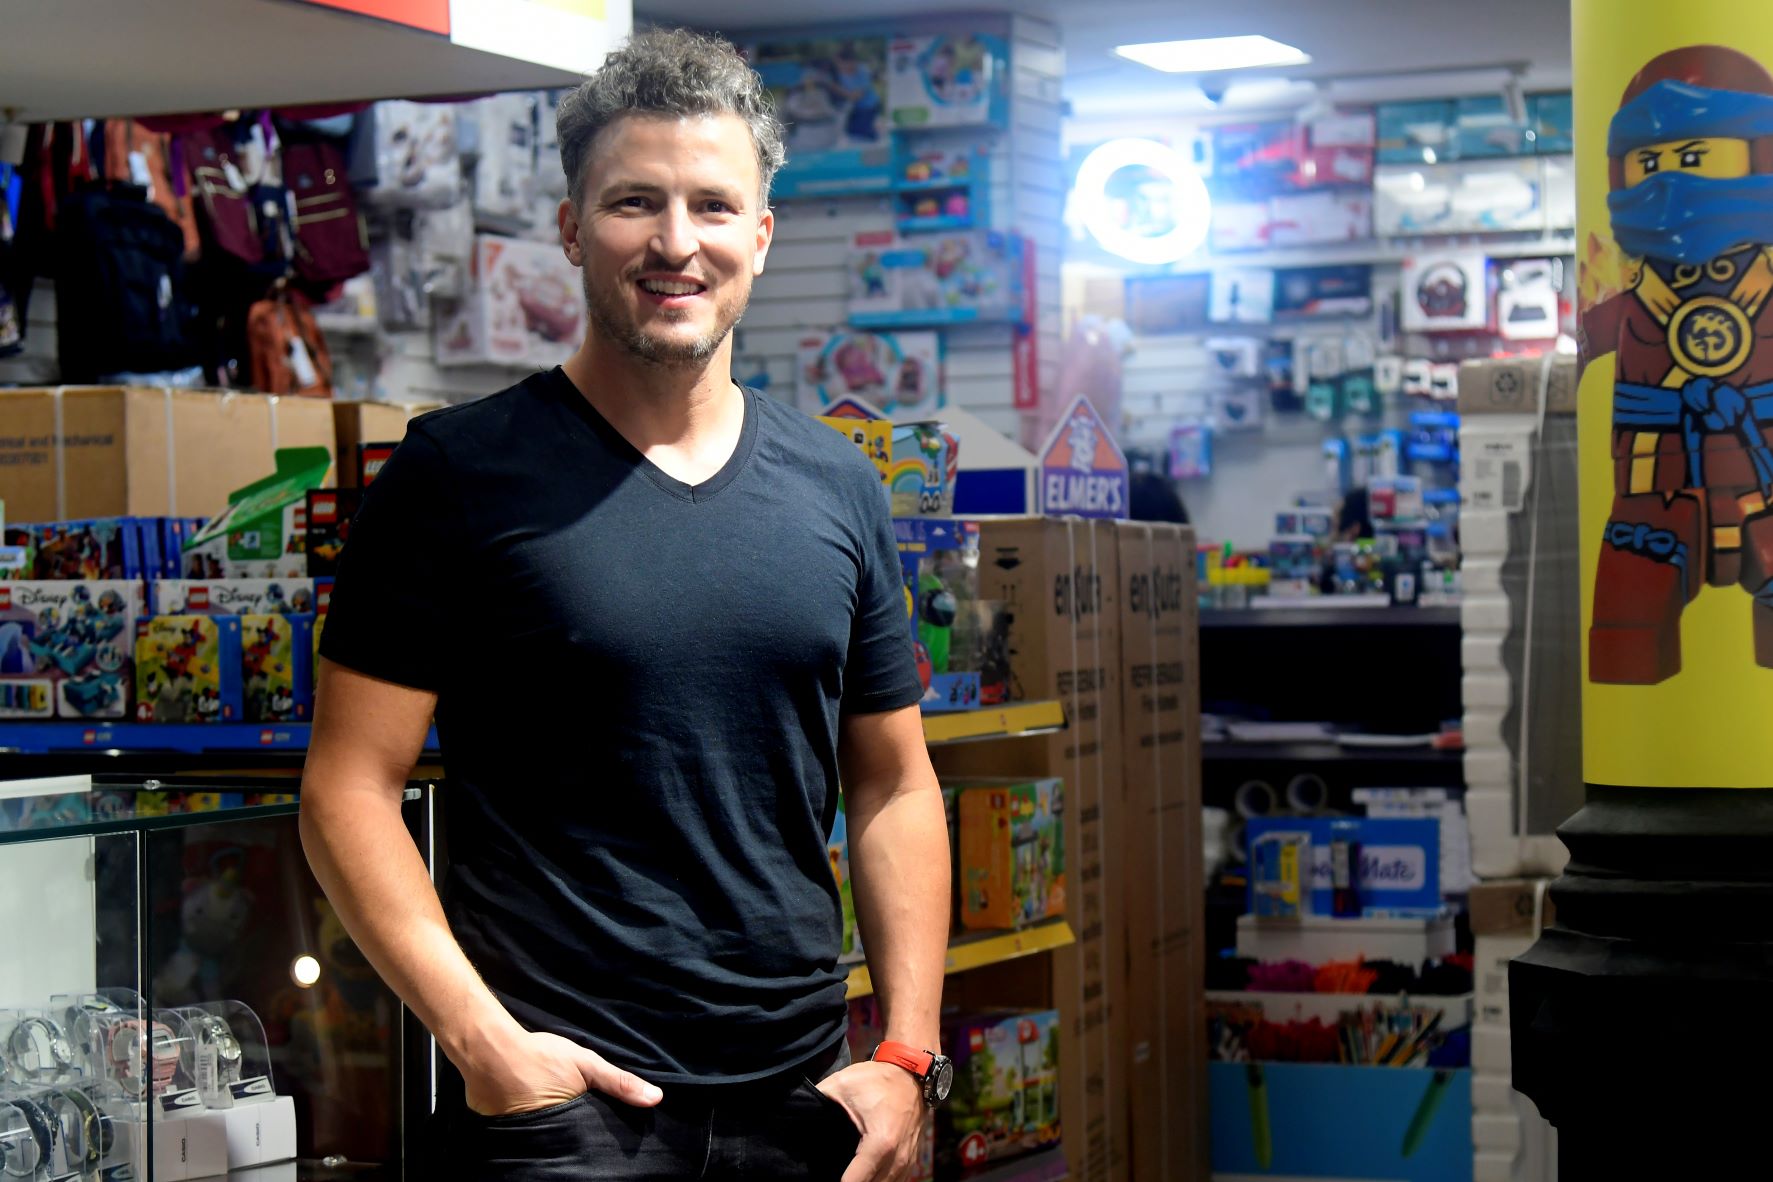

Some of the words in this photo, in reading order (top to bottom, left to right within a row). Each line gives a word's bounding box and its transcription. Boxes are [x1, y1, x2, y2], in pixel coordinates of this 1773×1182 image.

[1047, 475, 1122, 512] ELMER'S
[15, 586, 68, 608] Disney
[213, 585, 263, 608] Disney
